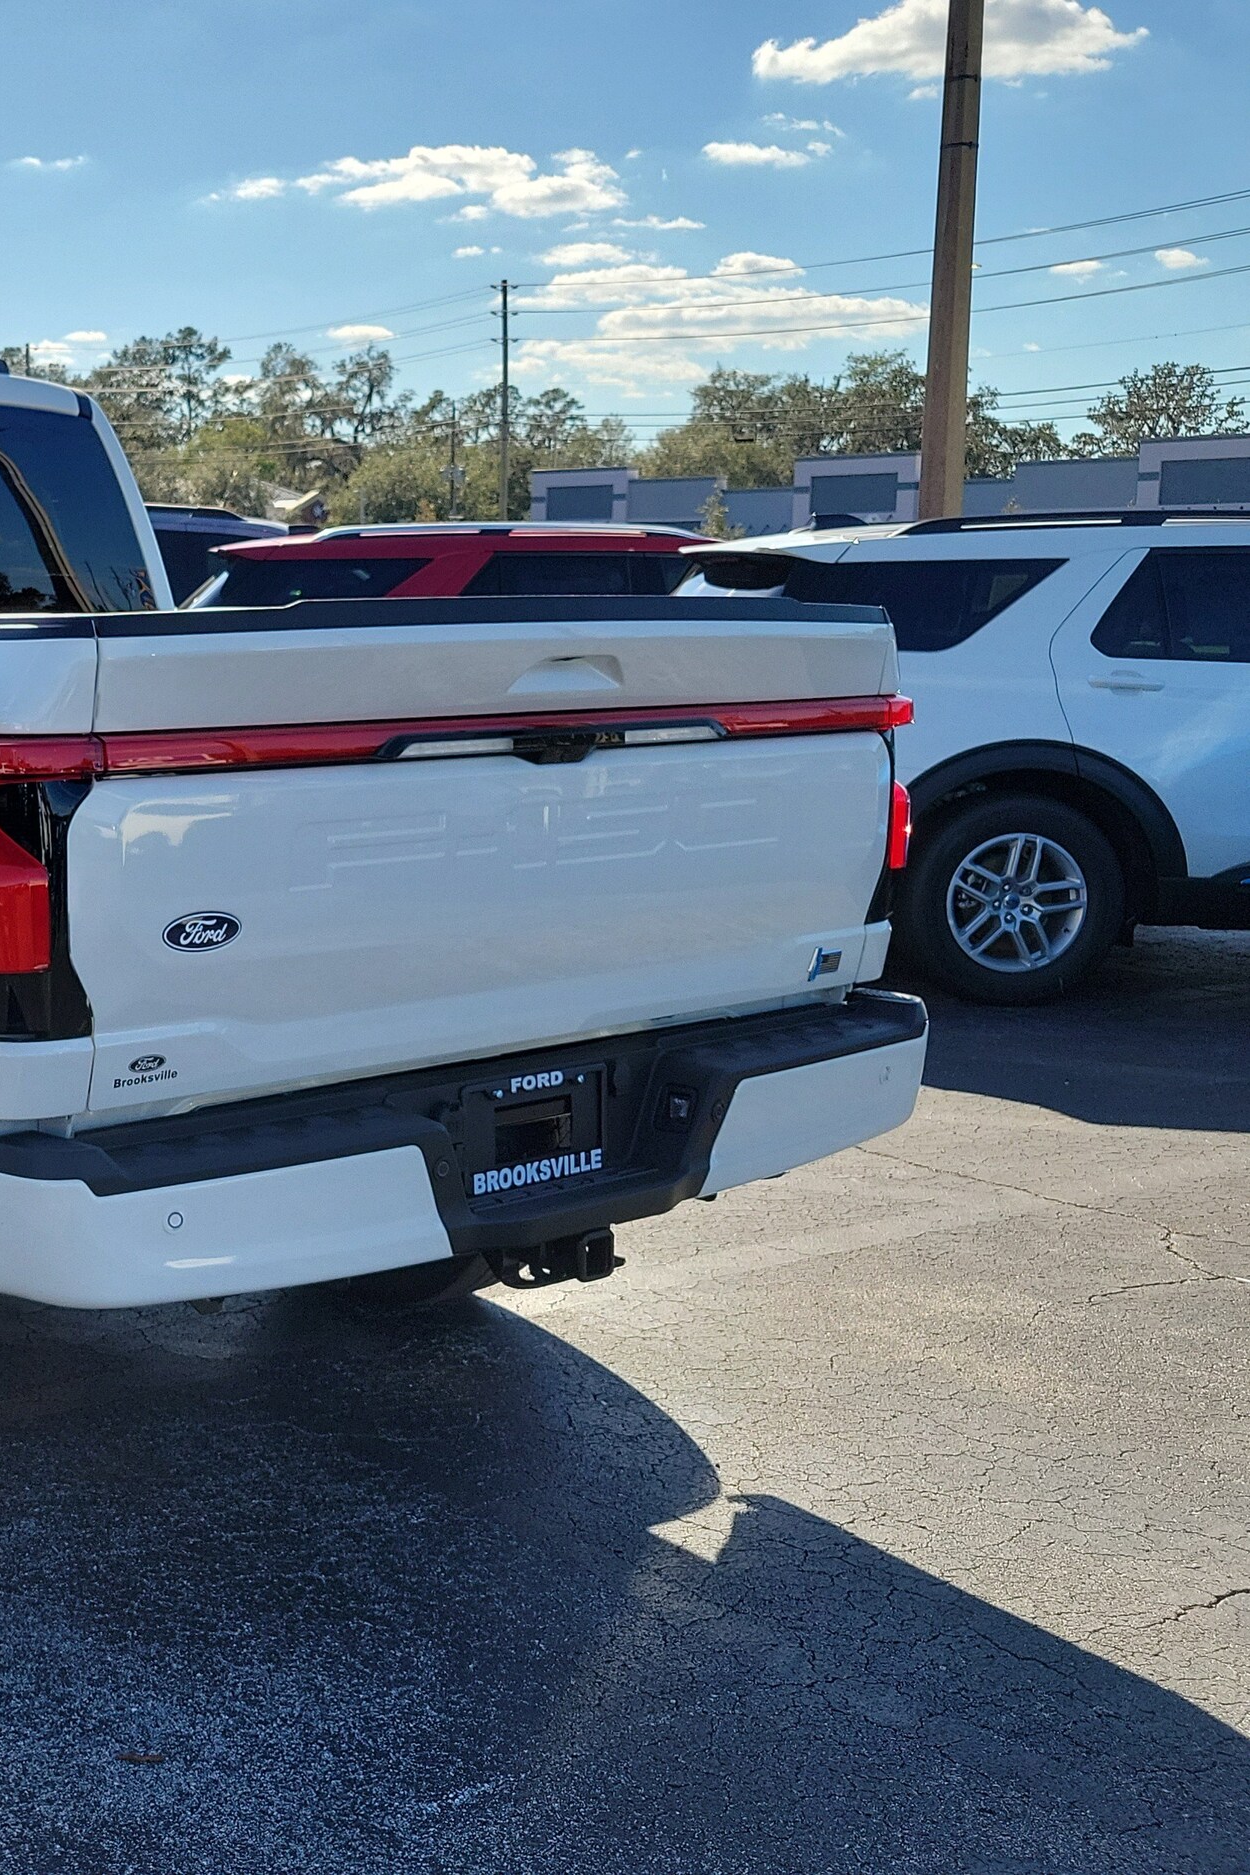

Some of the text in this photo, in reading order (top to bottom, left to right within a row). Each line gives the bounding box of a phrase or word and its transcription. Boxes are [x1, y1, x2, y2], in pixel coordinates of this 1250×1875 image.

[180, 919, 228, 945] Ford
[134, 1056, 160, 1071] Ford
[113, 1070, 178, 1089] Brooksville
[510, 1071, 564, 1093] FORD
[473, 1148, 603, 1195] BROOKSVILLE
